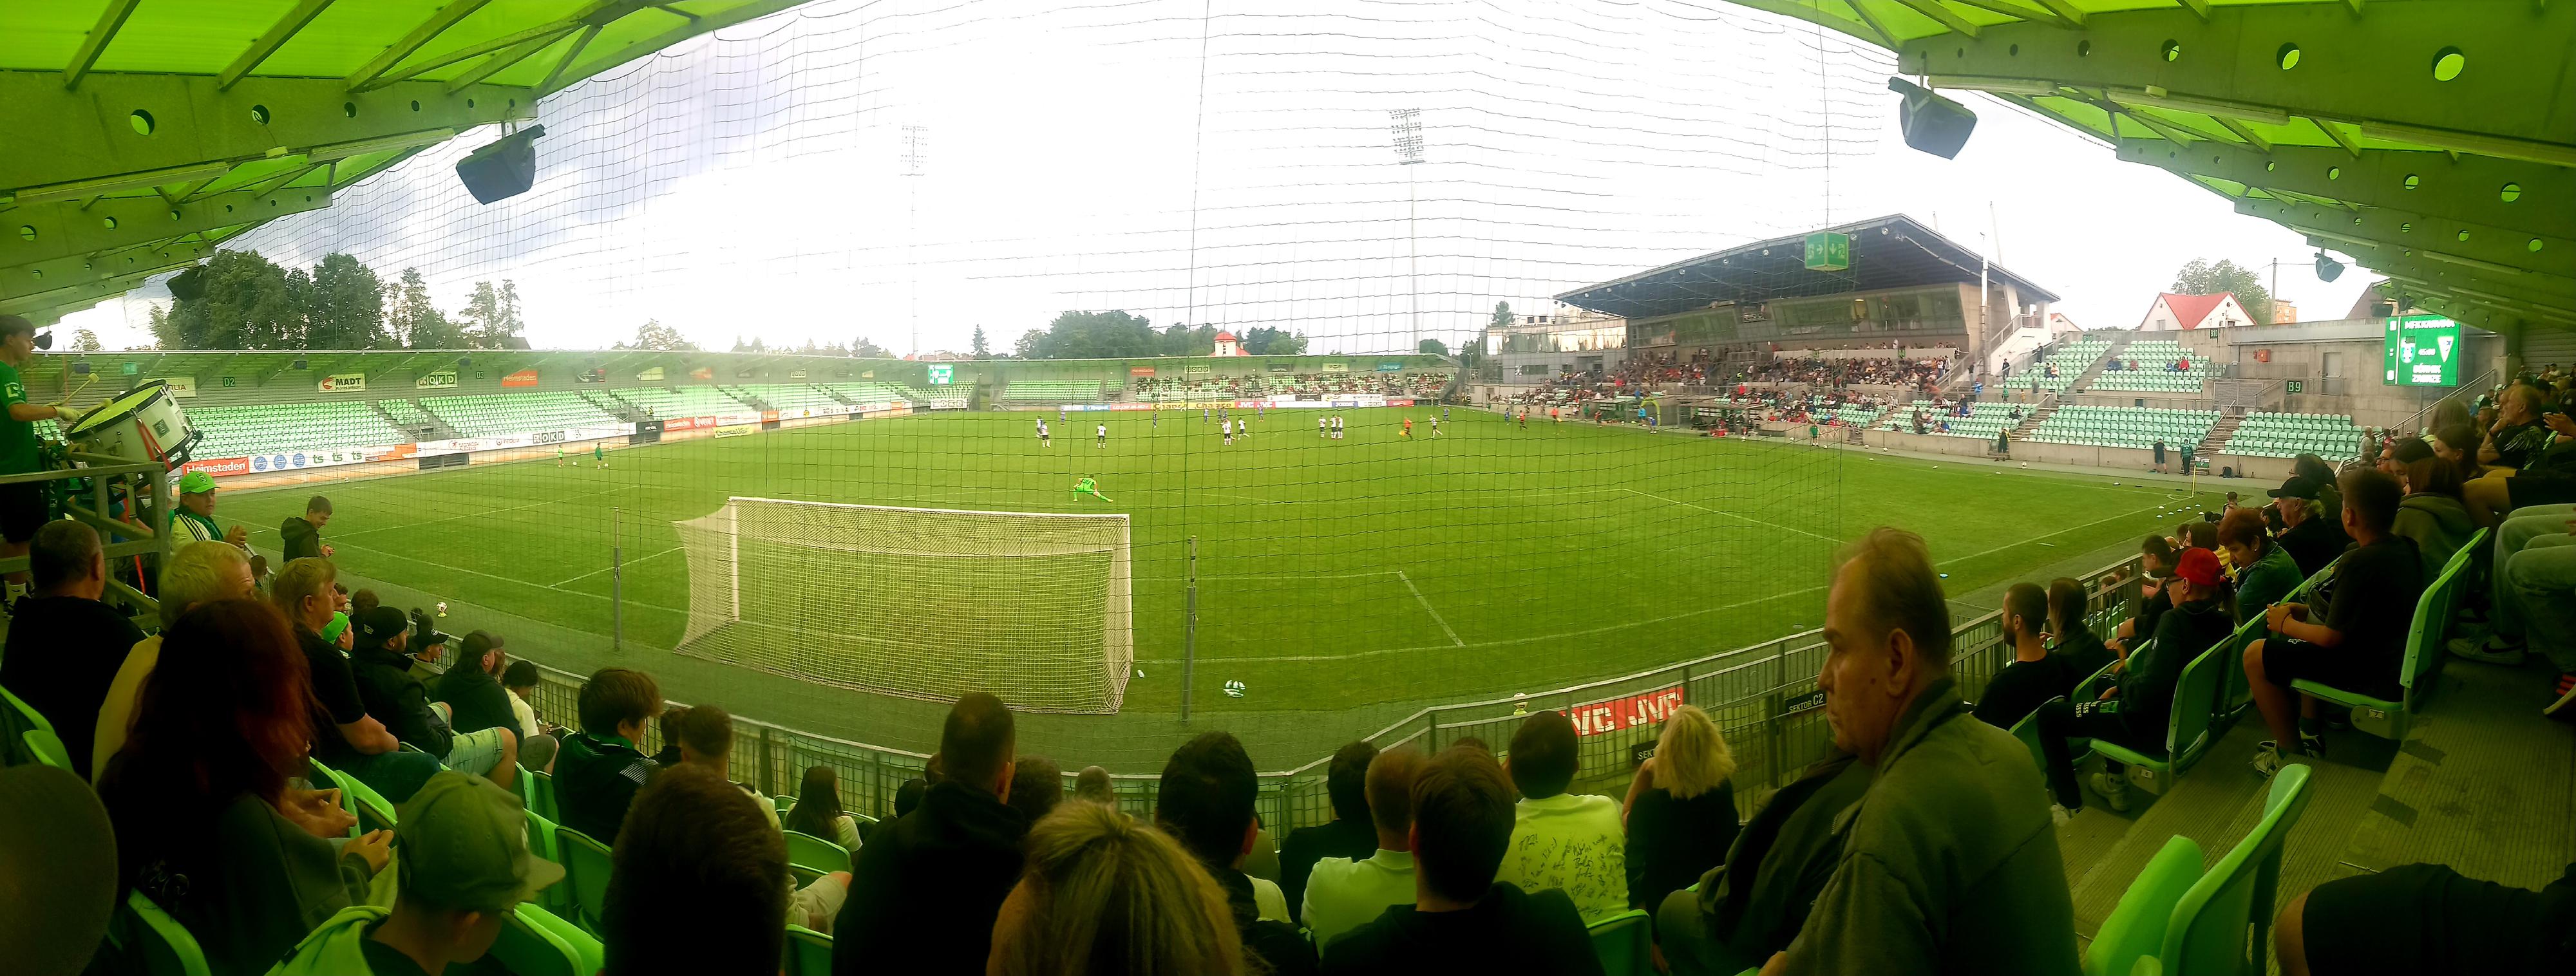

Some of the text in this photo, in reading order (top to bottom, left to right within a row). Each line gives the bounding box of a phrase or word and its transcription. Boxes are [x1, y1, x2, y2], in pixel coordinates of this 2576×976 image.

[224, 378, 235, 386] D2
[336, 377, 361, 386] MADT
[2288, 381, 2301, 392] B9
[312, 455, 323, 464] ts
[332, 453, 343, 462] ts
[352, 451, 362, 460] ts
[186, 462, 246, 474] Heimstaden
[1789, 693, 1824, 713] SEKTOR C2
[1628, 691, 1683, 726] JVC
[1570, 707, 1615, 736] VC
